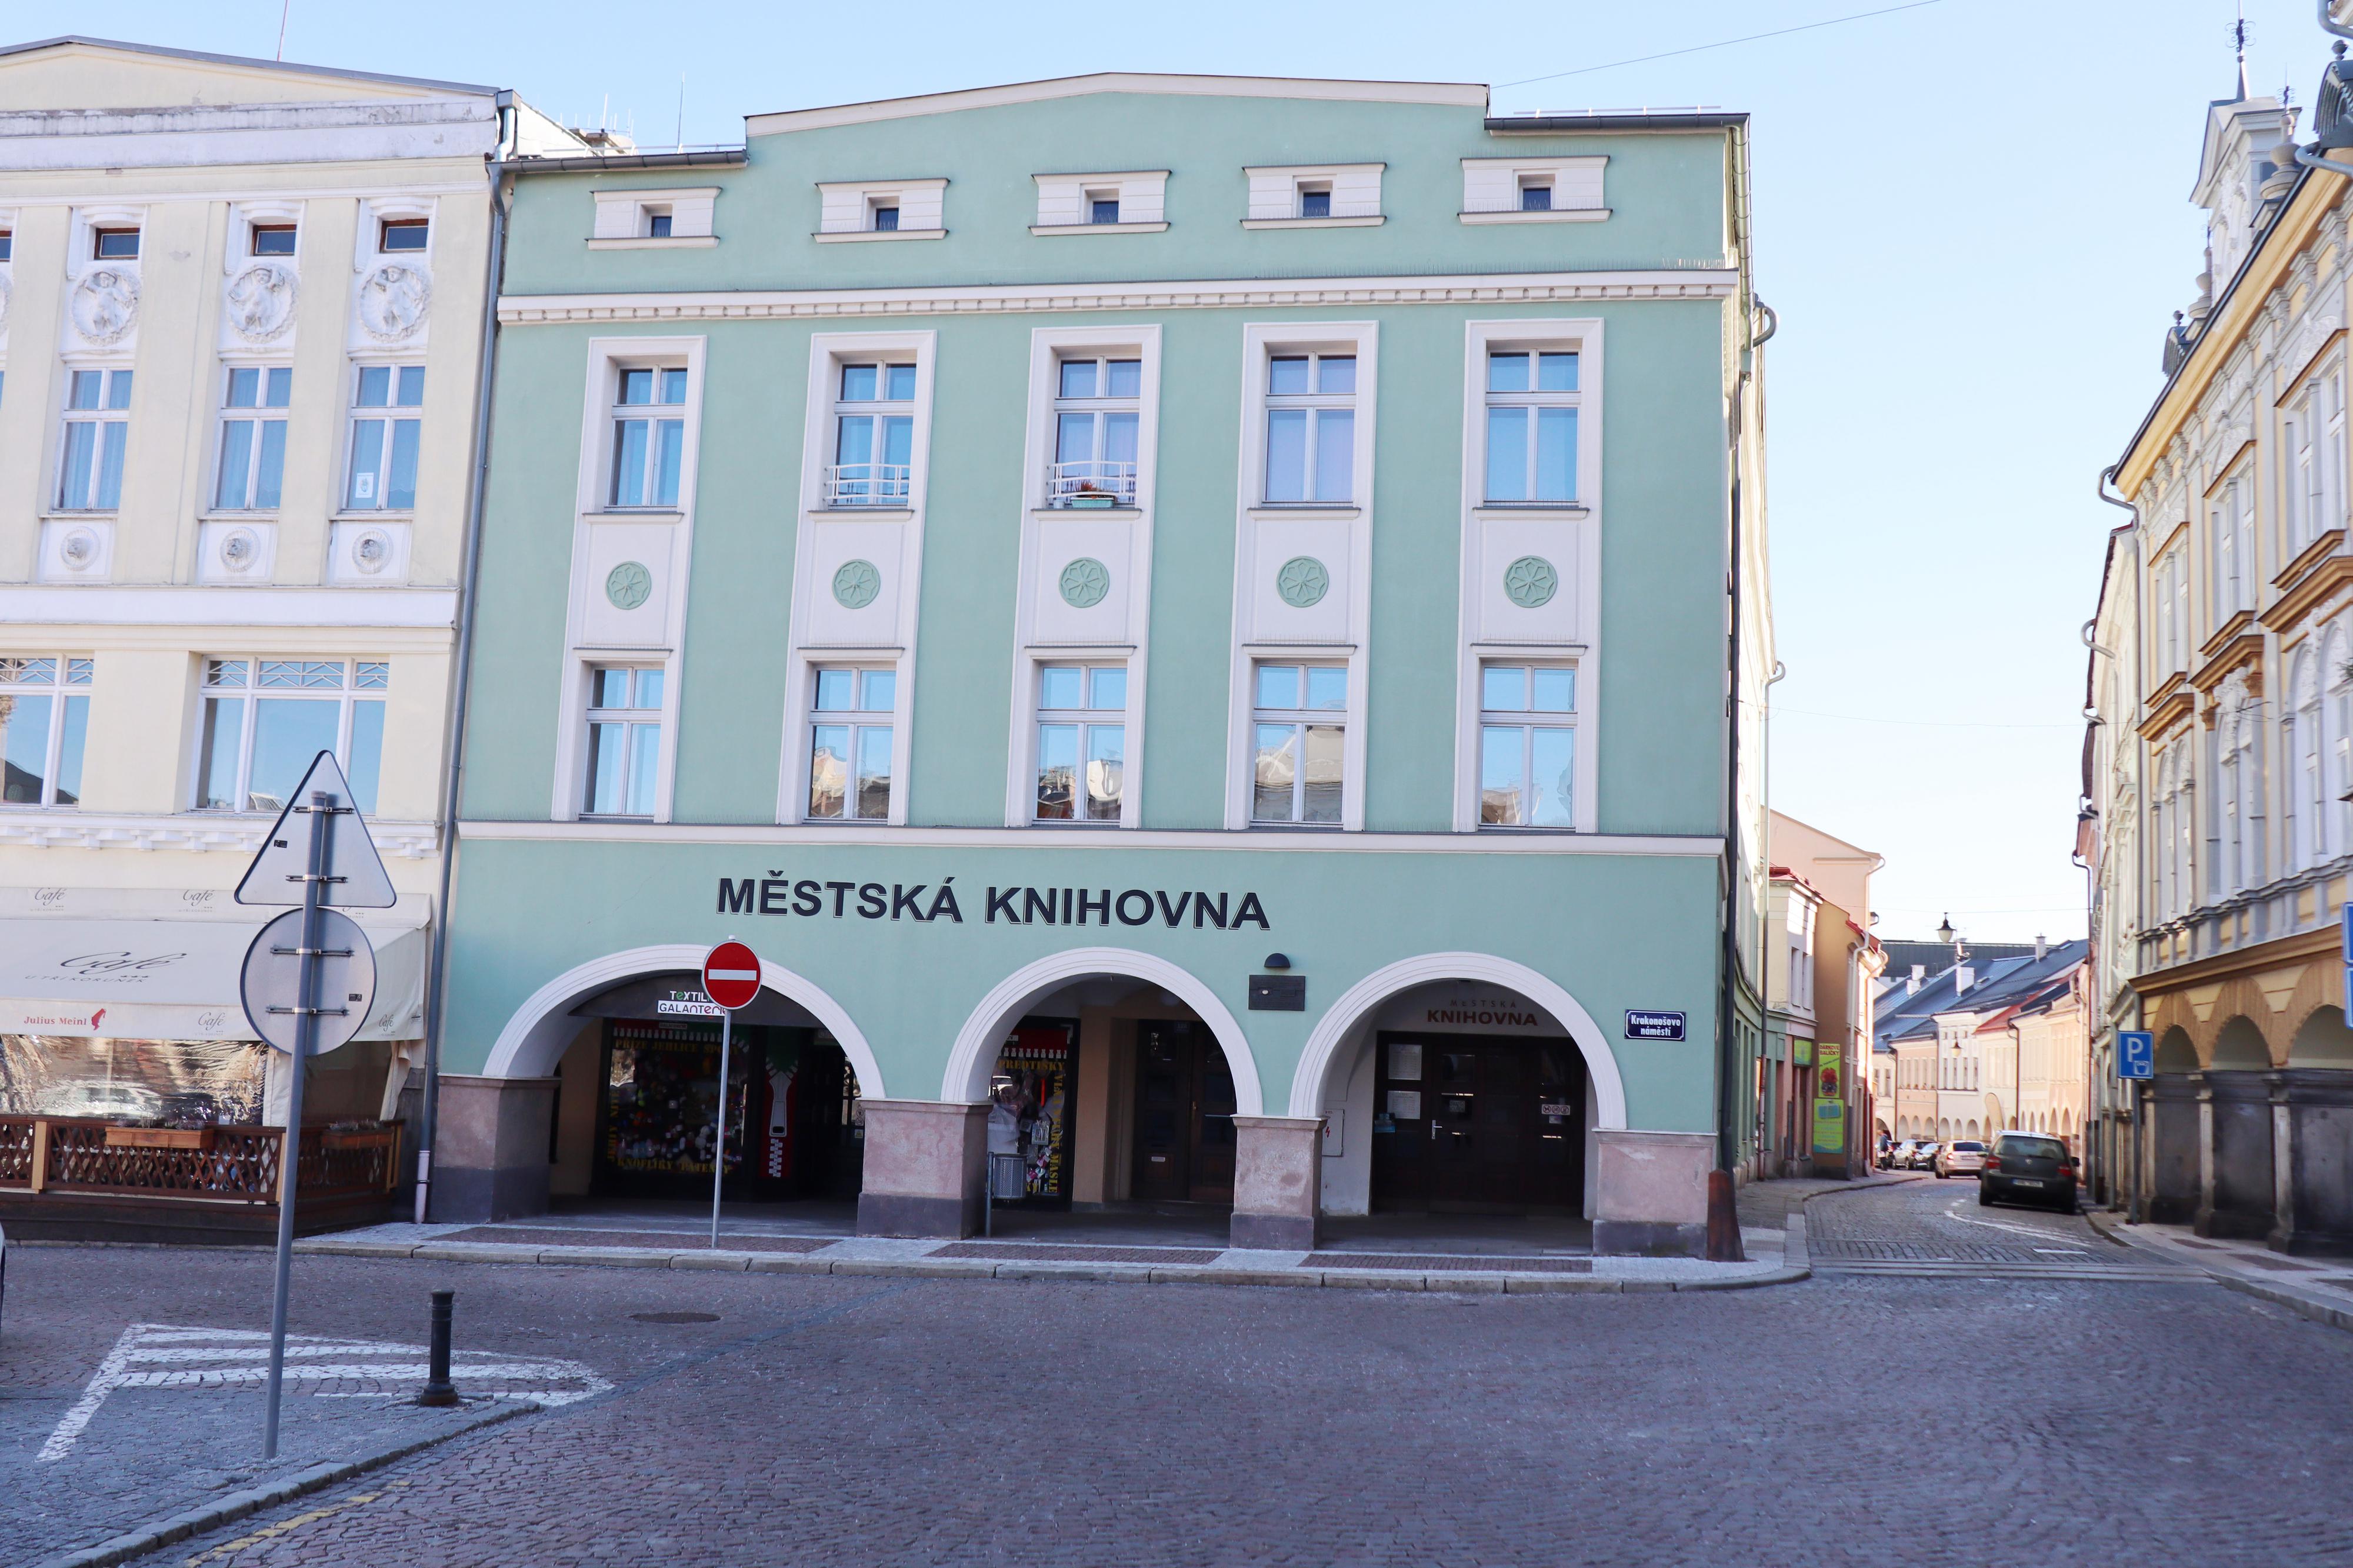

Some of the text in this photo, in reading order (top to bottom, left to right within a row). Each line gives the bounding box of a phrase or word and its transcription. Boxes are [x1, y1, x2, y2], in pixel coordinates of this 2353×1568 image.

[715, 871, 1271, 931] MĚSTSKÁ KNIHOVNA
[61, 952, 188, 975] Café
[24, 1016, 55, 1025] Julius
[198, 1012, 226, 1031] Café
[1427, 1009, 1538, 1026] KNIHOVNA
[1631, 1015, 1681, 1026] Krakonošovo
[1640, 1026, 1671, 1036] náměstí
[2127, 1037, 2144, 1062] P
